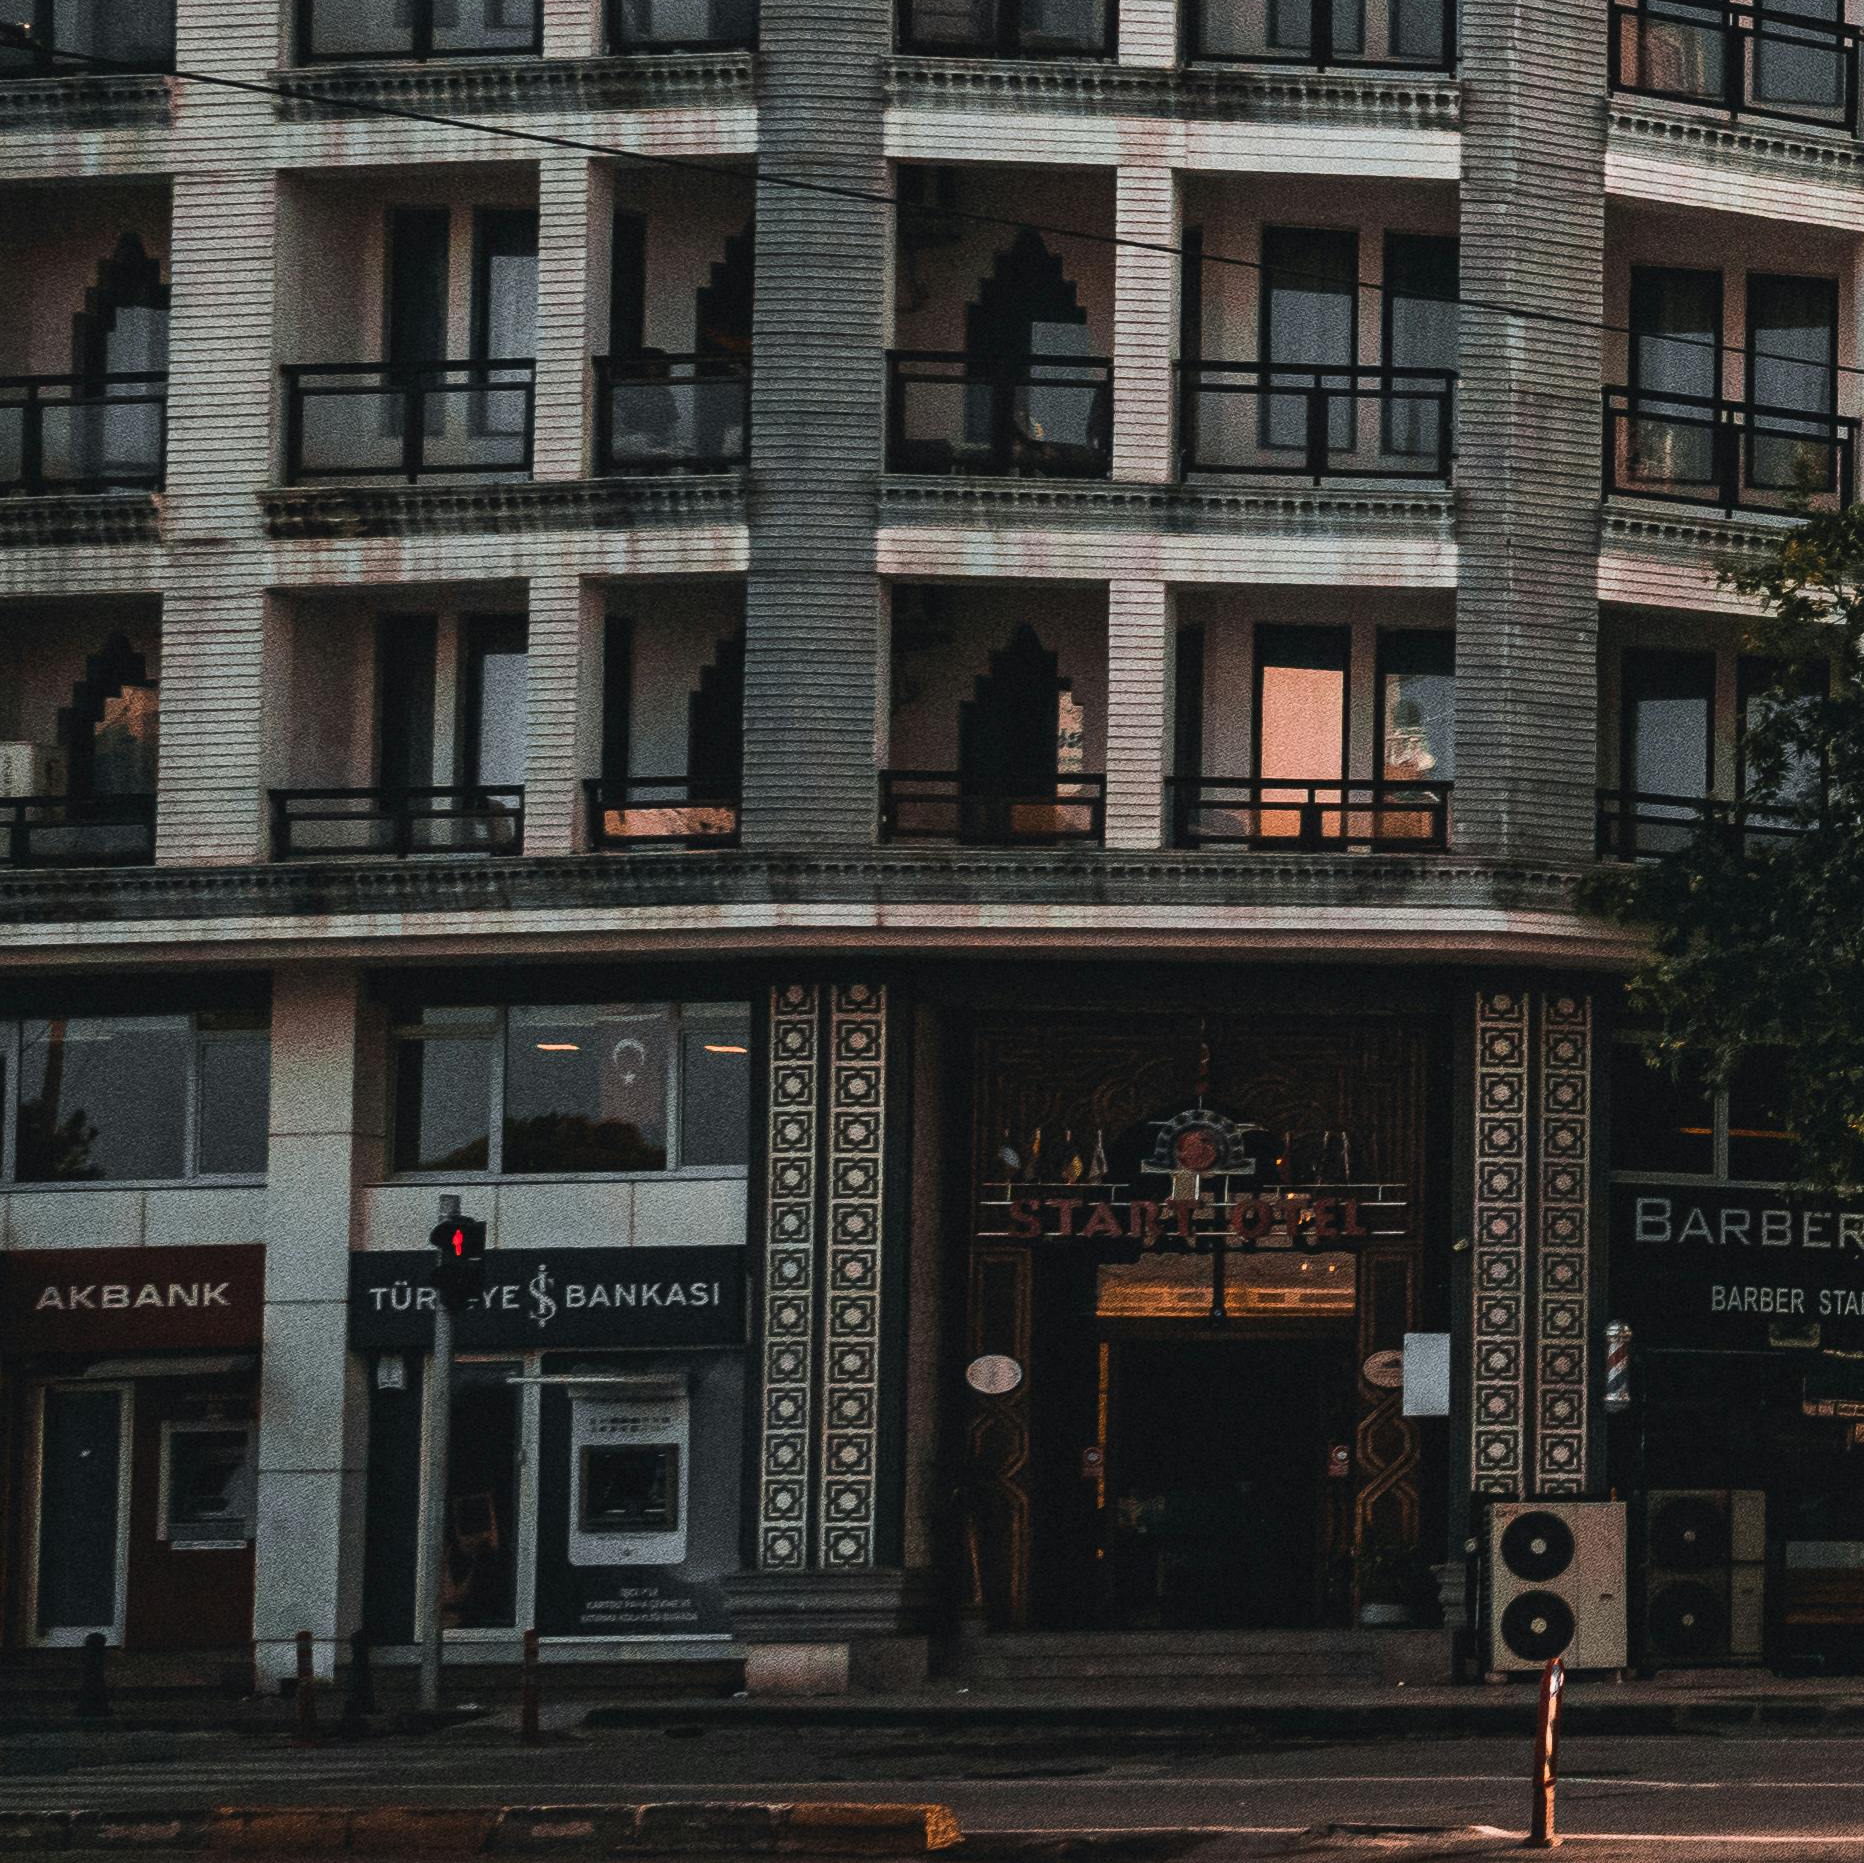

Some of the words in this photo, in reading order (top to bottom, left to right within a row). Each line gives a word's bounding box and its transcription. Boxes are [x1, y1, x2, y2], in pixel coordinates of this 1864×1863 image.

[1008, 1198, 1200, 1238] START
[1231, 1197, 1367, 1238] OTEL
[34, 1282, 231, 1311] AKBANK
[369, 1280, 522, 1311] TÜRYE
[564, 1281, 721, 1310] BANKASI
[1710, 1284, 1806, 1314] BARBER
